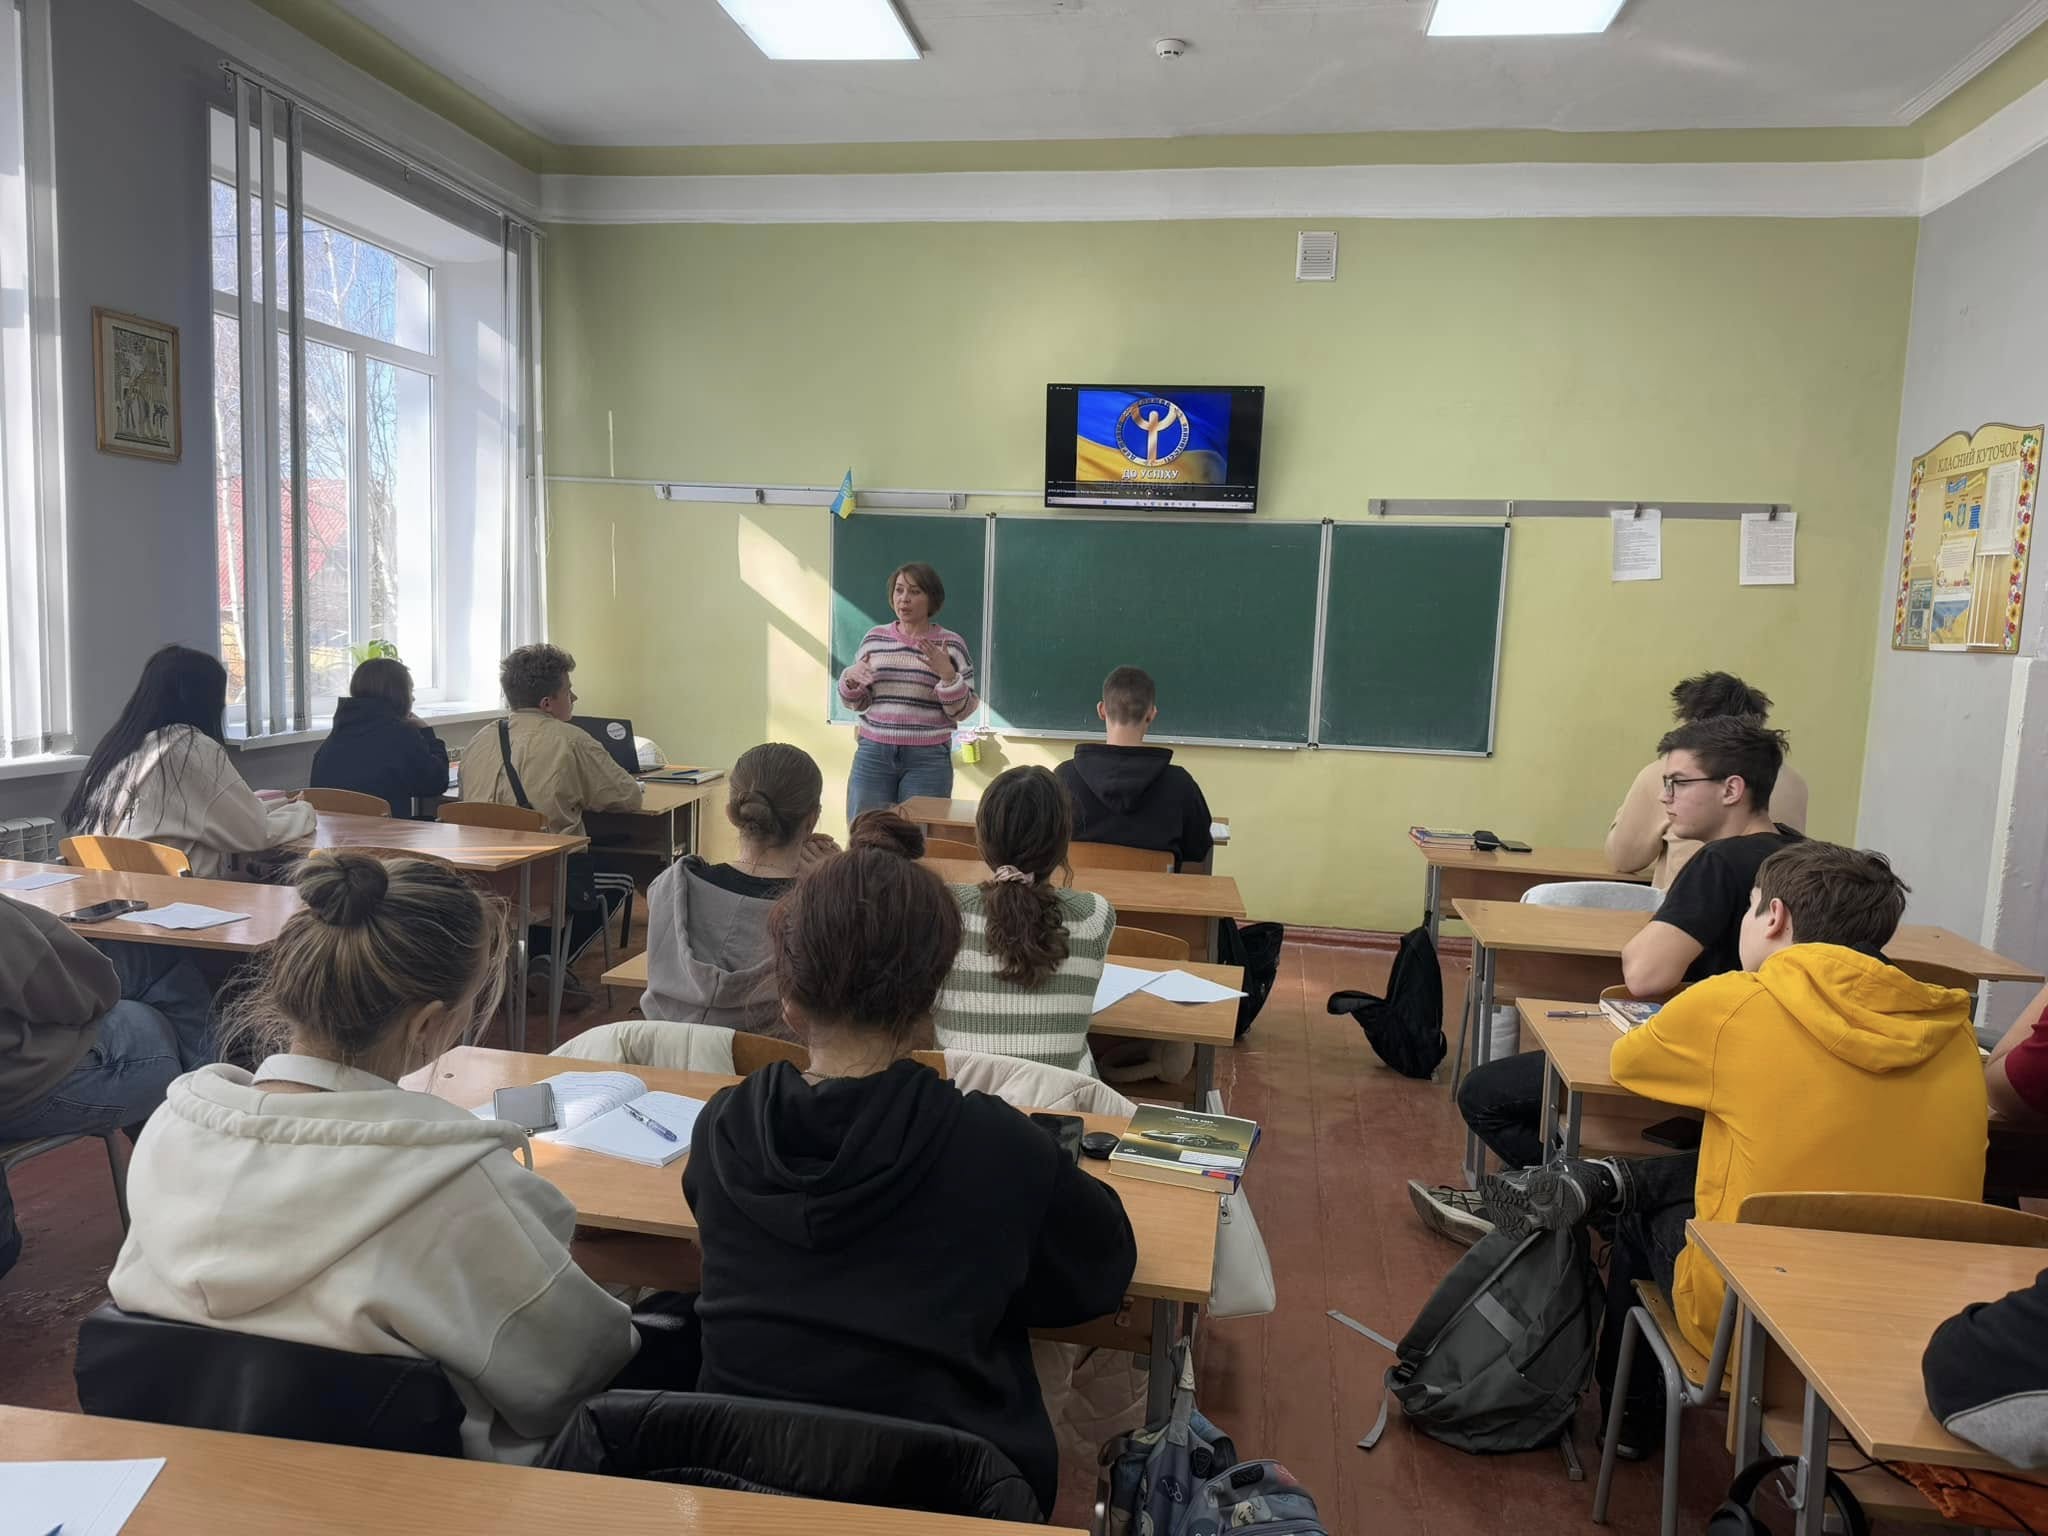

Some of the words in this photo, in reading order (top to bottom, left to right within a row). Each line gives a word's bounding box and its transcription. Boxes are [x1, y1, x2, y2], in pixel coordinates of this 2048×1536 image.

[1937, 449, 1976, 472] КЛАСНИЙ
[1976, 440, 2018, 463] КУТОЧОК
[1122, 469, 1137, 480] ДО
[1141, 469, 1178, 479] УСПІХУ
